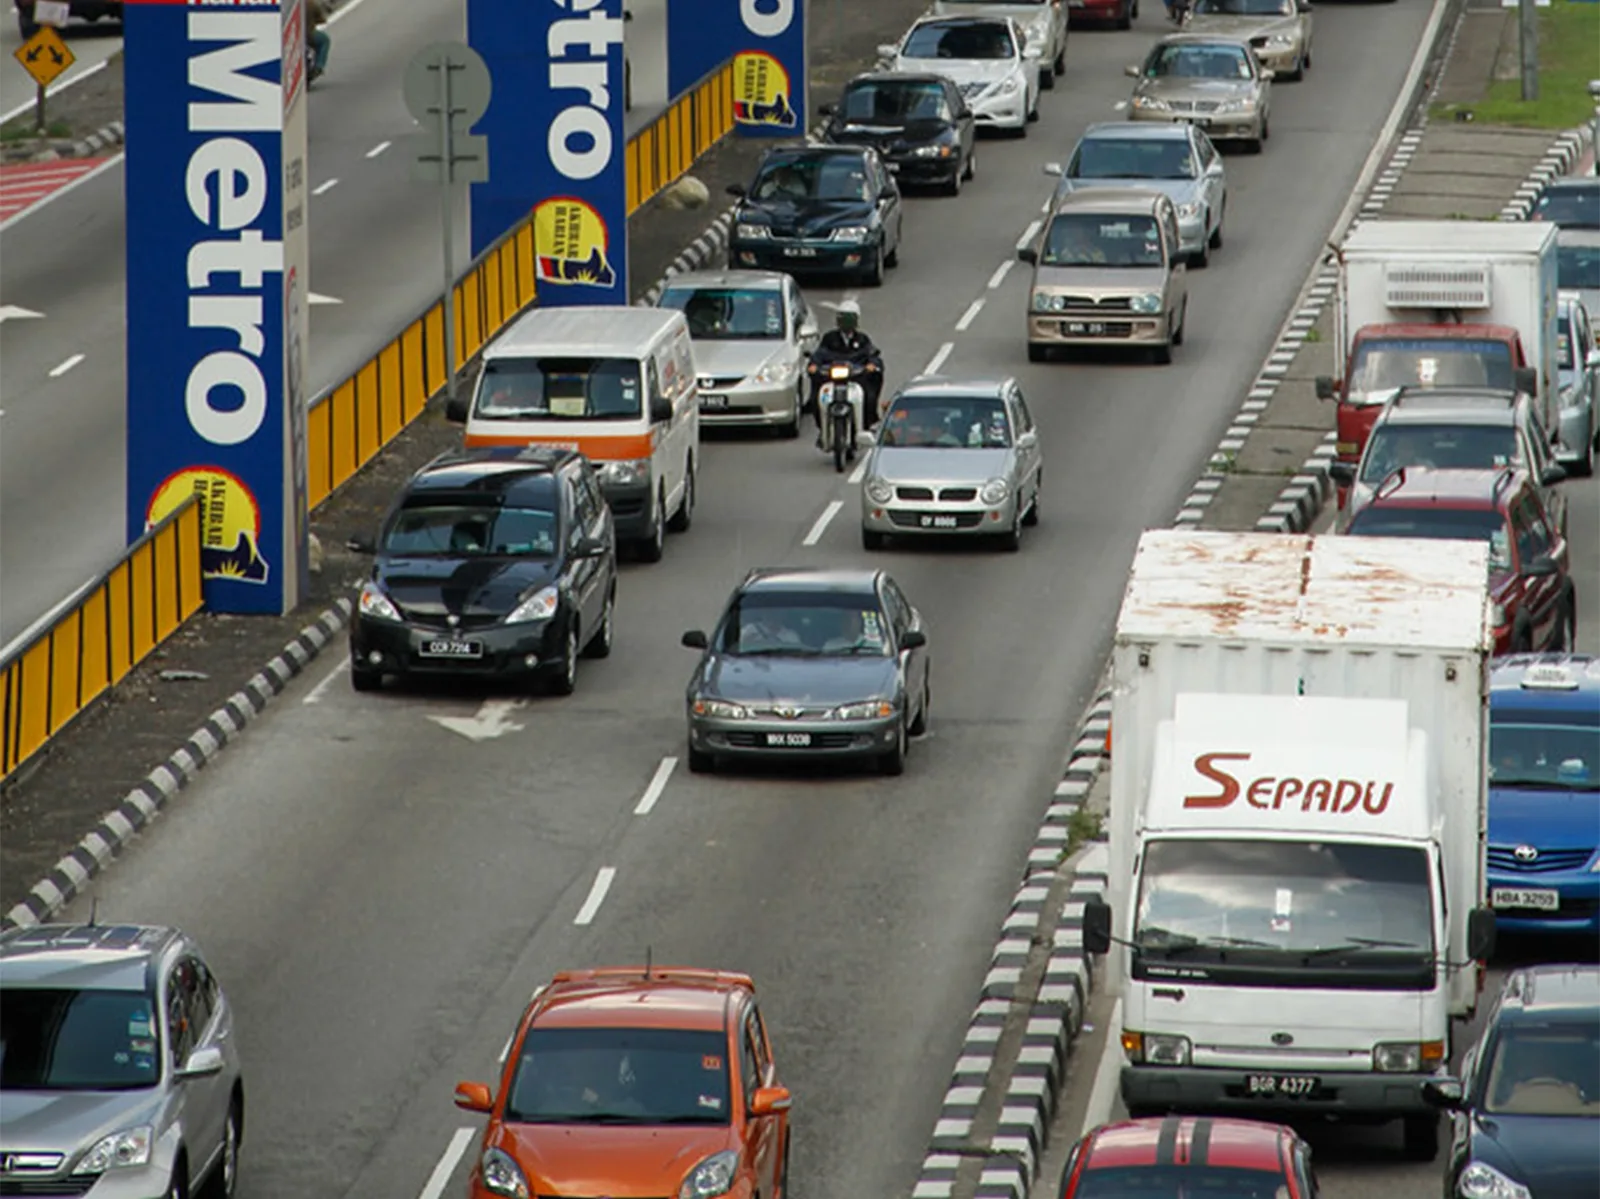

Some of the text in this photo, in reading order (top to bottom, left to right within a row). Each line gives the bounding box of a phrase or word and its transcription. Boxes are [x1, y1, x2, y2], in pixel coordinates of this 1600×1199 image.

[547, 0, 625, 181] tro
[185, 12, 284, 446] Metro
[553, 206, 567, 255] HARIAN
[567, 206, 581, 258] AKHBAR
[207, 480, 226, 545] AKHBAR
[1183, 752, 1394, 815] SEPADU
